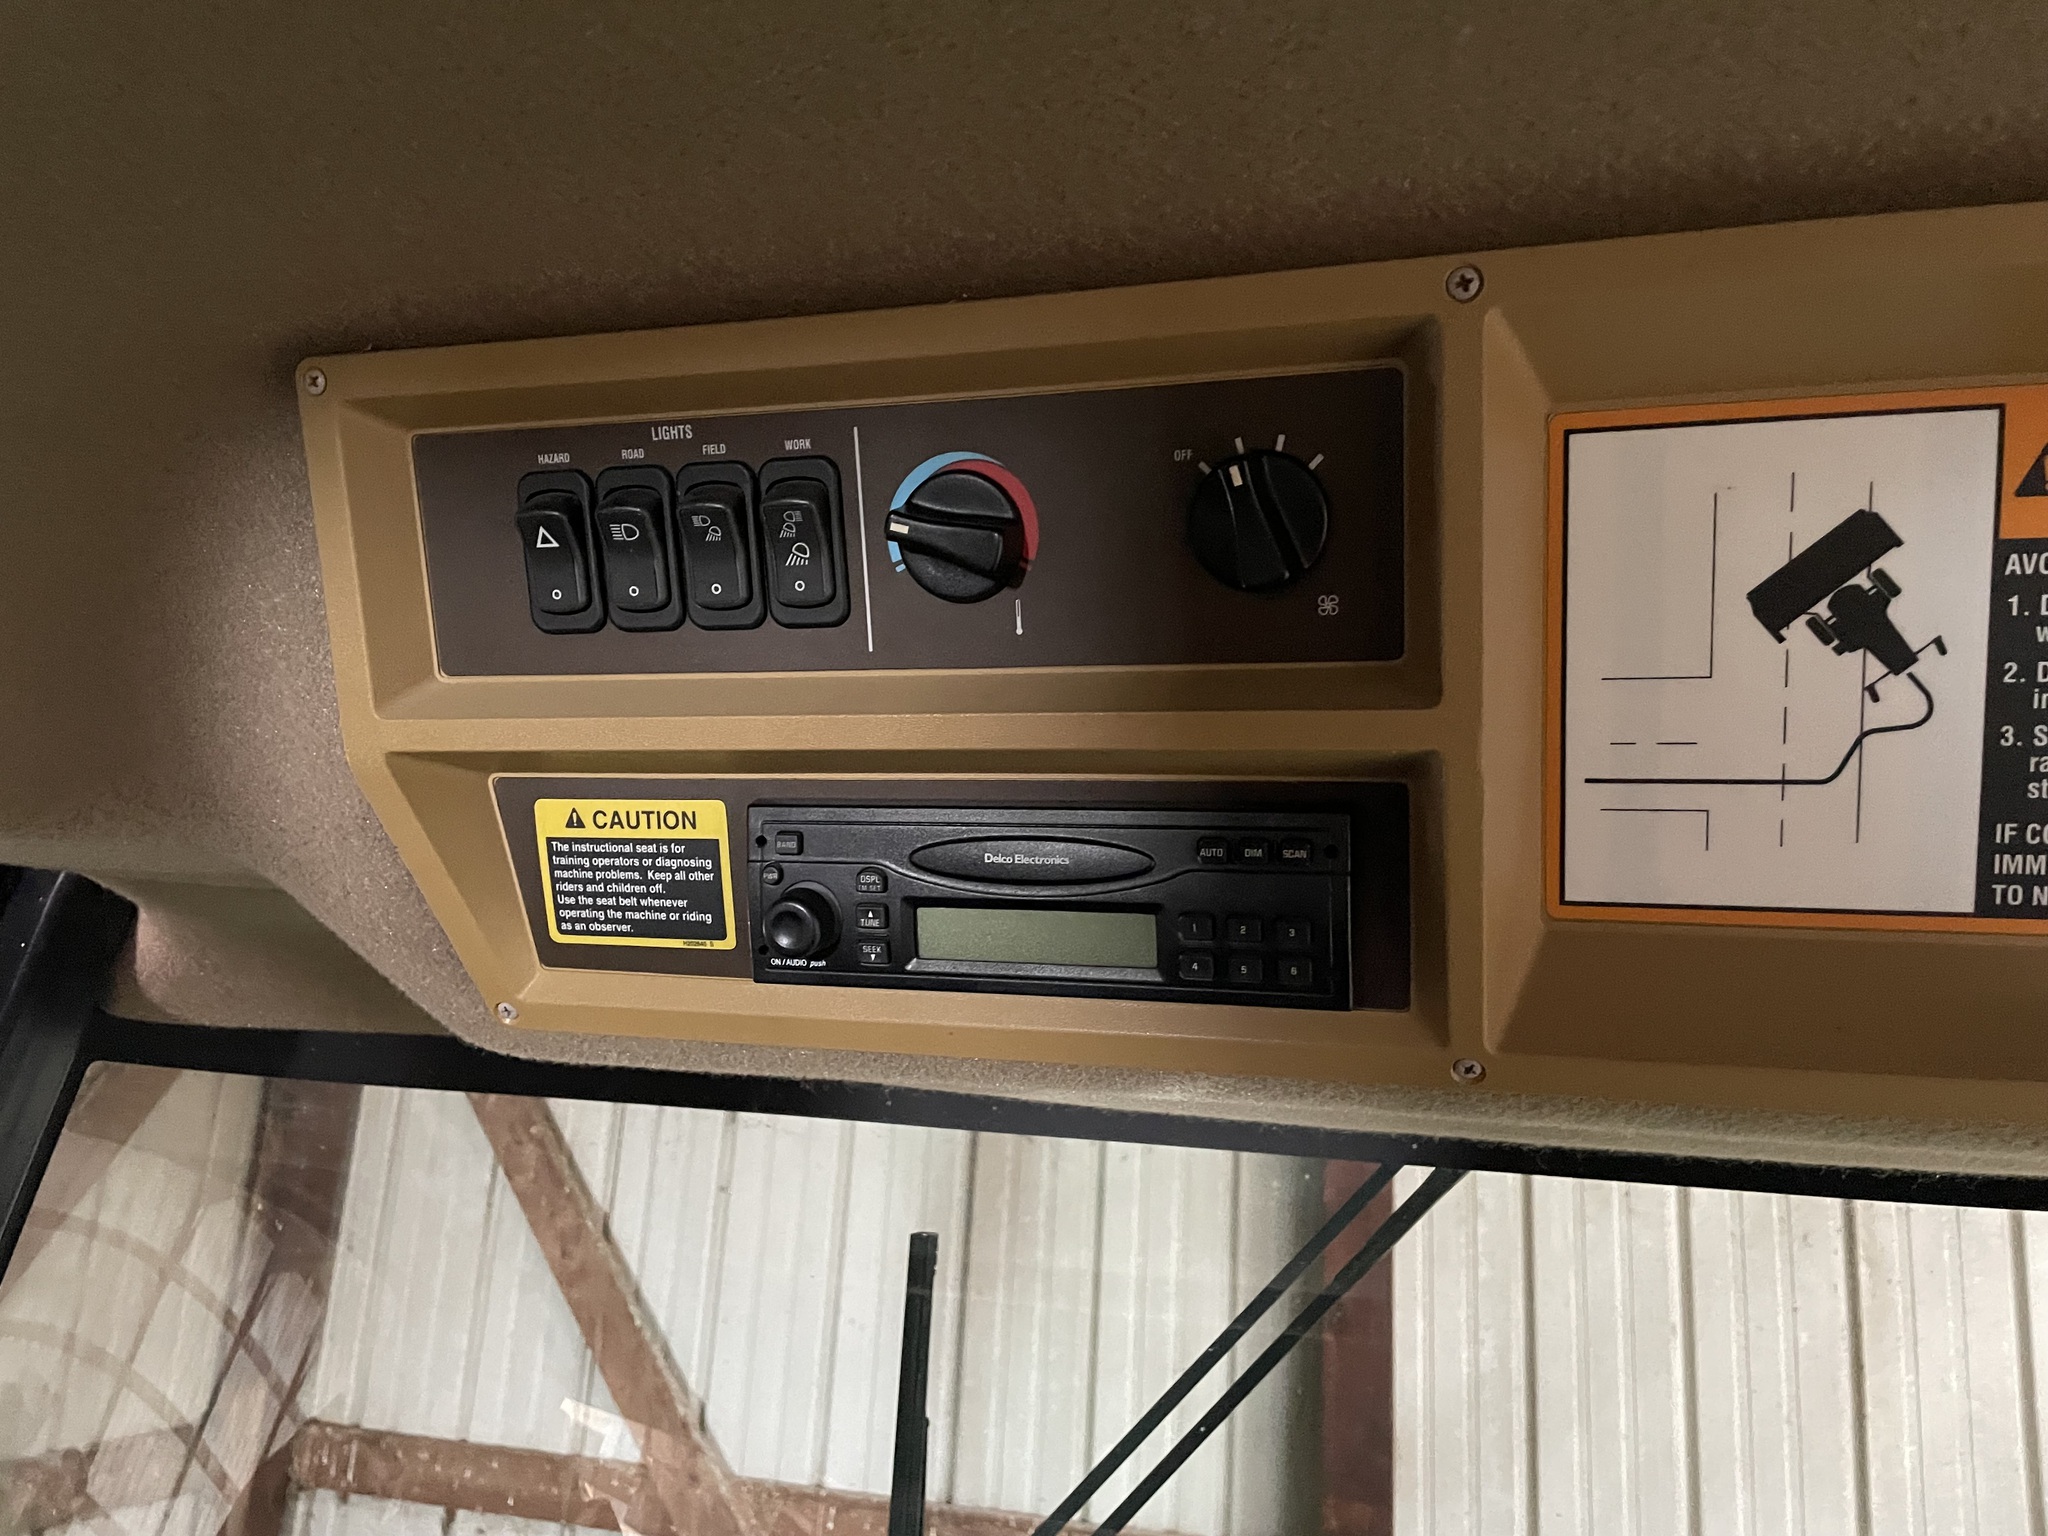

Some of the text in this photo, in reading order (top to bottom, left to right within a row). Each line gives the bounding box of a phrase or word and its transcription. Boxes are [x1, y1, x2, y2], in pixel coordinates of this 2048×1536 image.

[651, 424, 693, 441] LIGHTS
[702, 443, 726, 455] FIELD
[784, 438, 812, 451] WORK
[537, 452, 570, 464] HAZARD
[621, 448, 645, 460] ROAD
[1174, 448, 1194, 461] OFF
[2008, 594, 2030, 616] 1.
[2003, 661, 2026, 683] 2.
[2000, 725, 2023, 747] 3.
[592, 810, 697, 830] CAUTION
[1995, 823, 2018, 844] IF
[551, 841, 686, 853] The instructional seat is for
[776, 841, 797, 849] BAND
[1200, 848, 1224, 857] AUTO
[1244, 848, 1263, 857] DIM
[1282, 849, 1307, 858] SCAN
[552, 855, 712, 870] training operators or diagnosing
[984, 853, 1070, 865] Delco Electronics
[1993, 853, 2047, 876] IMM
[554, 868, 714, 883] machine problems. Keep all other
[860, 874, 881, 884] DSPL
[556, 881, 666, 894] riders and children off.
[557, 894, 688, 908] Use the seat belt whenever
[1991, 884, 2024, 906] TO
[559, 908, 712, 924] operating the machine or riding
[561, 921, 634, 932] as an observer.
[860, 918, 880, 927] TUNE
[1240, 925, 1247, 935] 2
[1288, 928, 1296, 937] 3
[862, 945, 882, 953] SEEK
[809, 959, 827, 969] push
[1191, 962, 1198, 971] 4
[1240, 965, 1247, 974] 5
